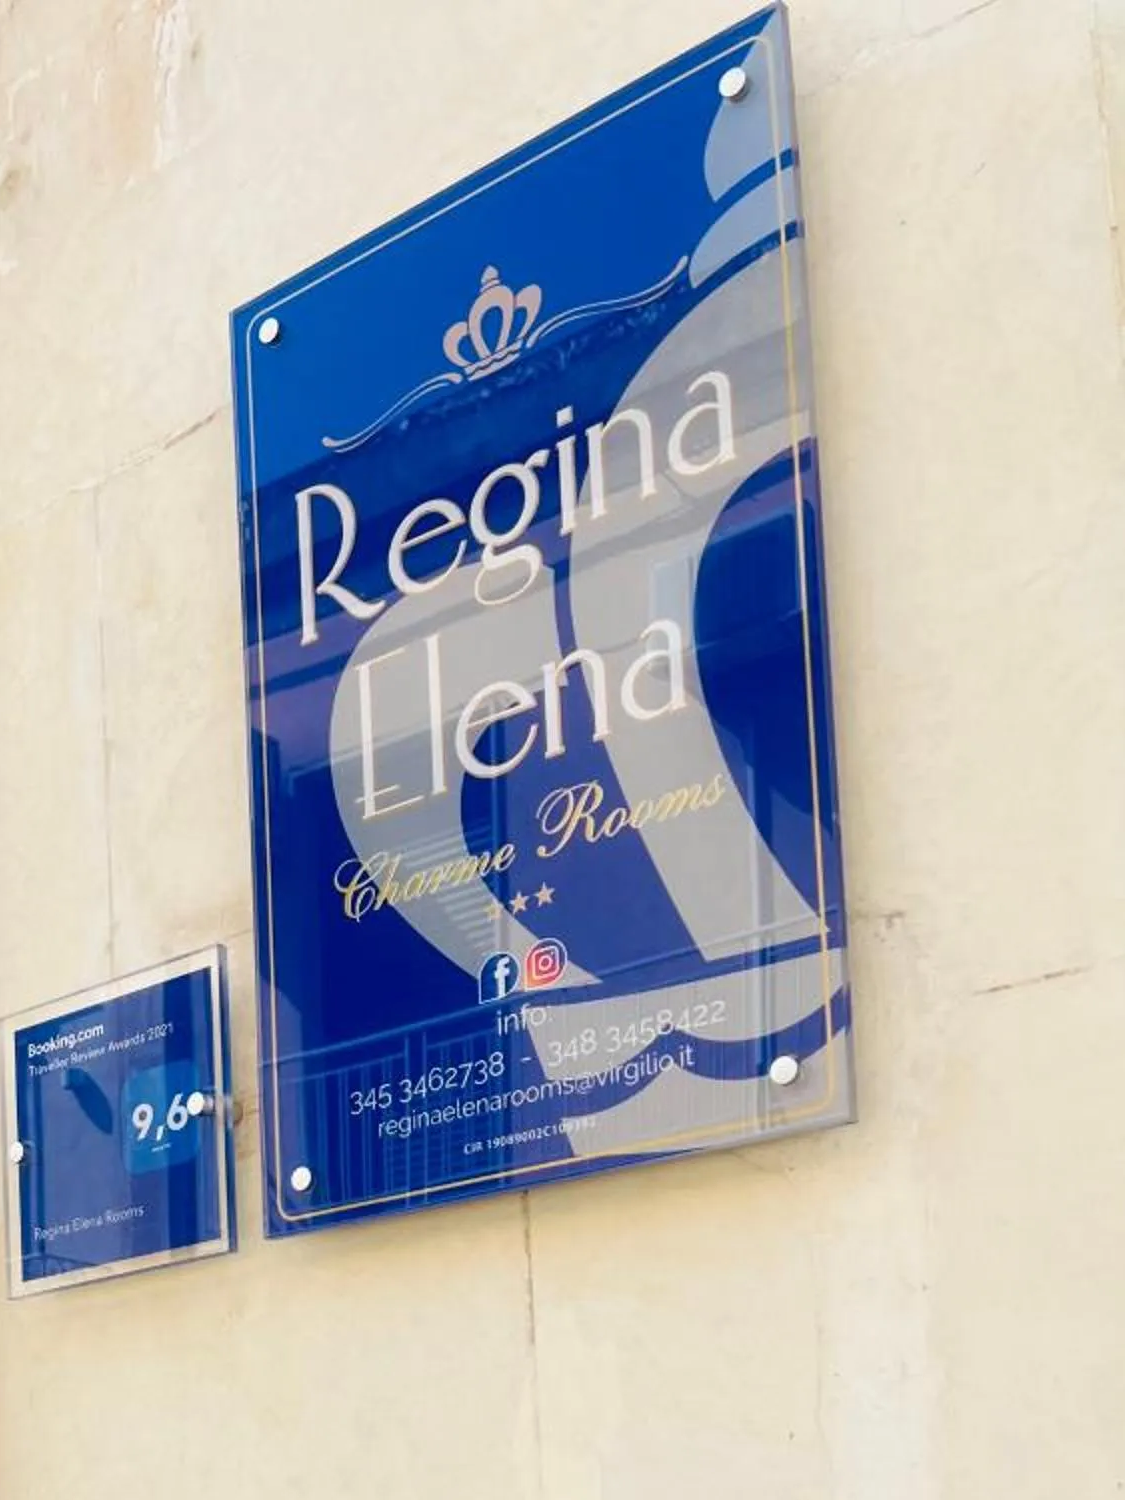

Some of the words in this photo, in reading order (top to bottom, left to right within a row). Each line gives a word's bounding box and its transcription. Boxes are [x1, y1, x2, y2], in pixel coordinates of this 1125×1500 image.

[295, 369, 738, 647] Regina
[355, 618, 690, 821] Elena
[333, 841, 516, 923] Charme
[535, 772, 727, 859] Rooms
[27, 1023, 105, 1058] Booking.com
[108, 1032, 146, 1053] Awards
[349, 1083, 393, 1116] 345
[398, 1051, 506, 1104] 3462738
[547, 1028, 597, 1068] 348
[605, 999, 727, 1053] 3458422
[377, 1044, 696, 1139] reginaelenarooms@virgilio.it
[132, 1092, 189, 1142] 9,6
